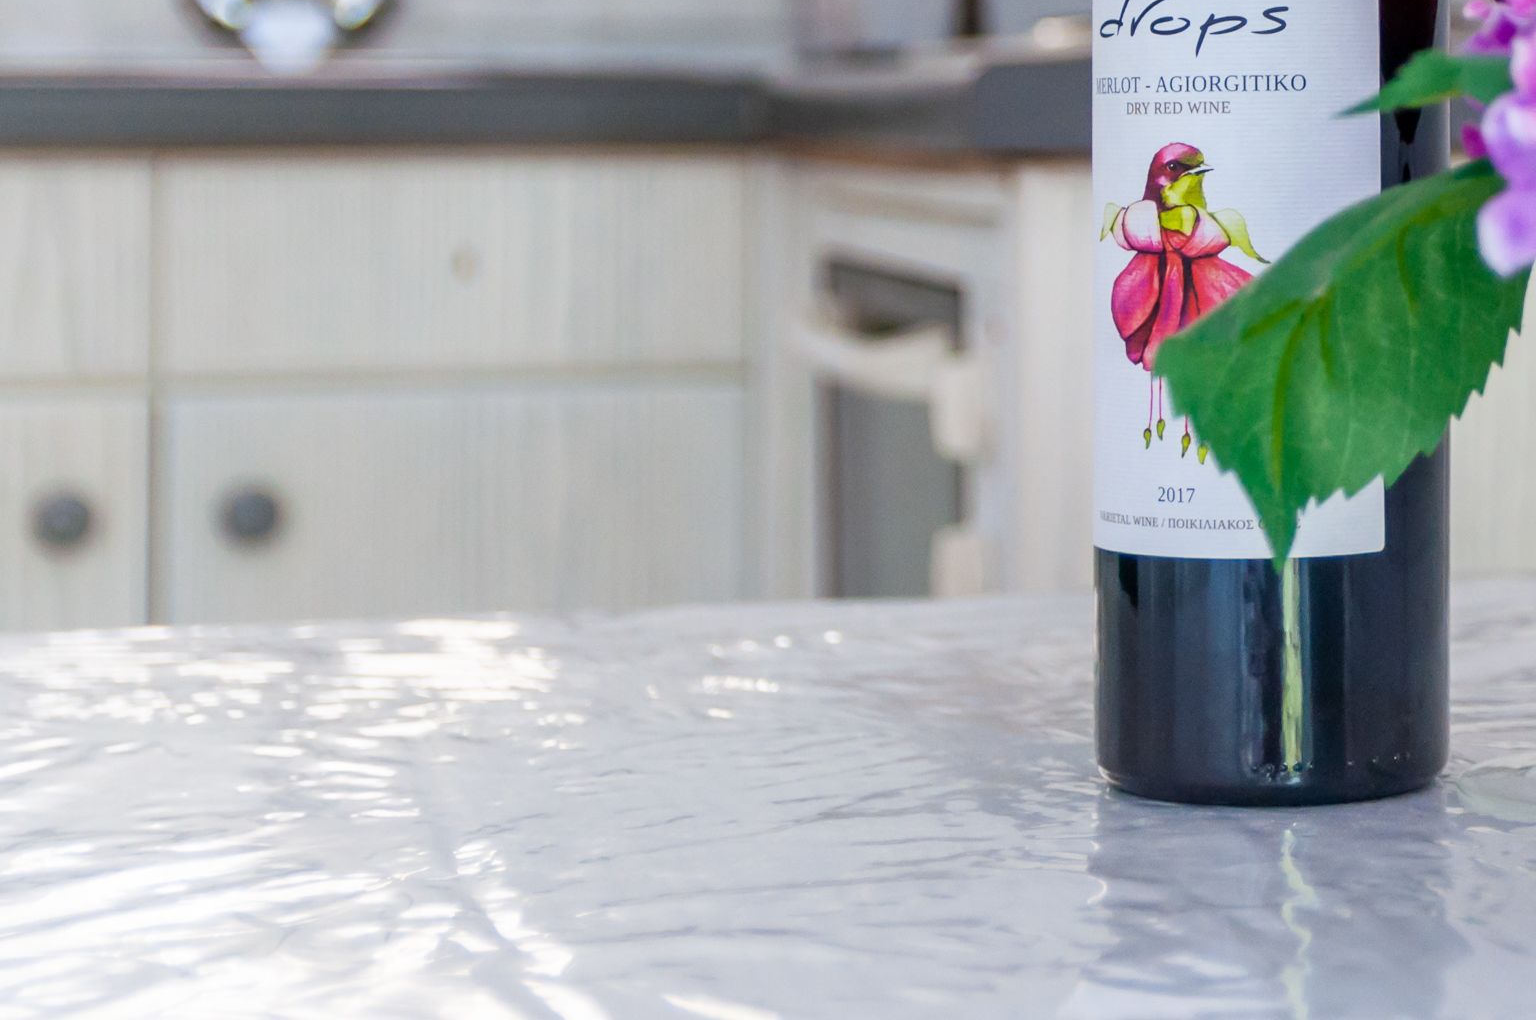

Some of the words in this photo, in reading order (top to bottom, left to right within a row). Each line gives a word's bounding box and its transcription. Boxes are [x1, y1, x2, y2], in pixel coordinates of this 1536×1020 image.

[1155, 74, 1308, 93] AGIORGITIKO
[1126, 101, 1149, 115] DRY
[1154, 101, 1183, 115] RED
[1188, 100, 1231, 114] WINE
[1157, 486, 1196, 503] 2017
[1133, 515, 1159, 528] WINE
[1167, 518, 1254, 530] ΠΟΙΚΙΛΙΑΚΟΣ
